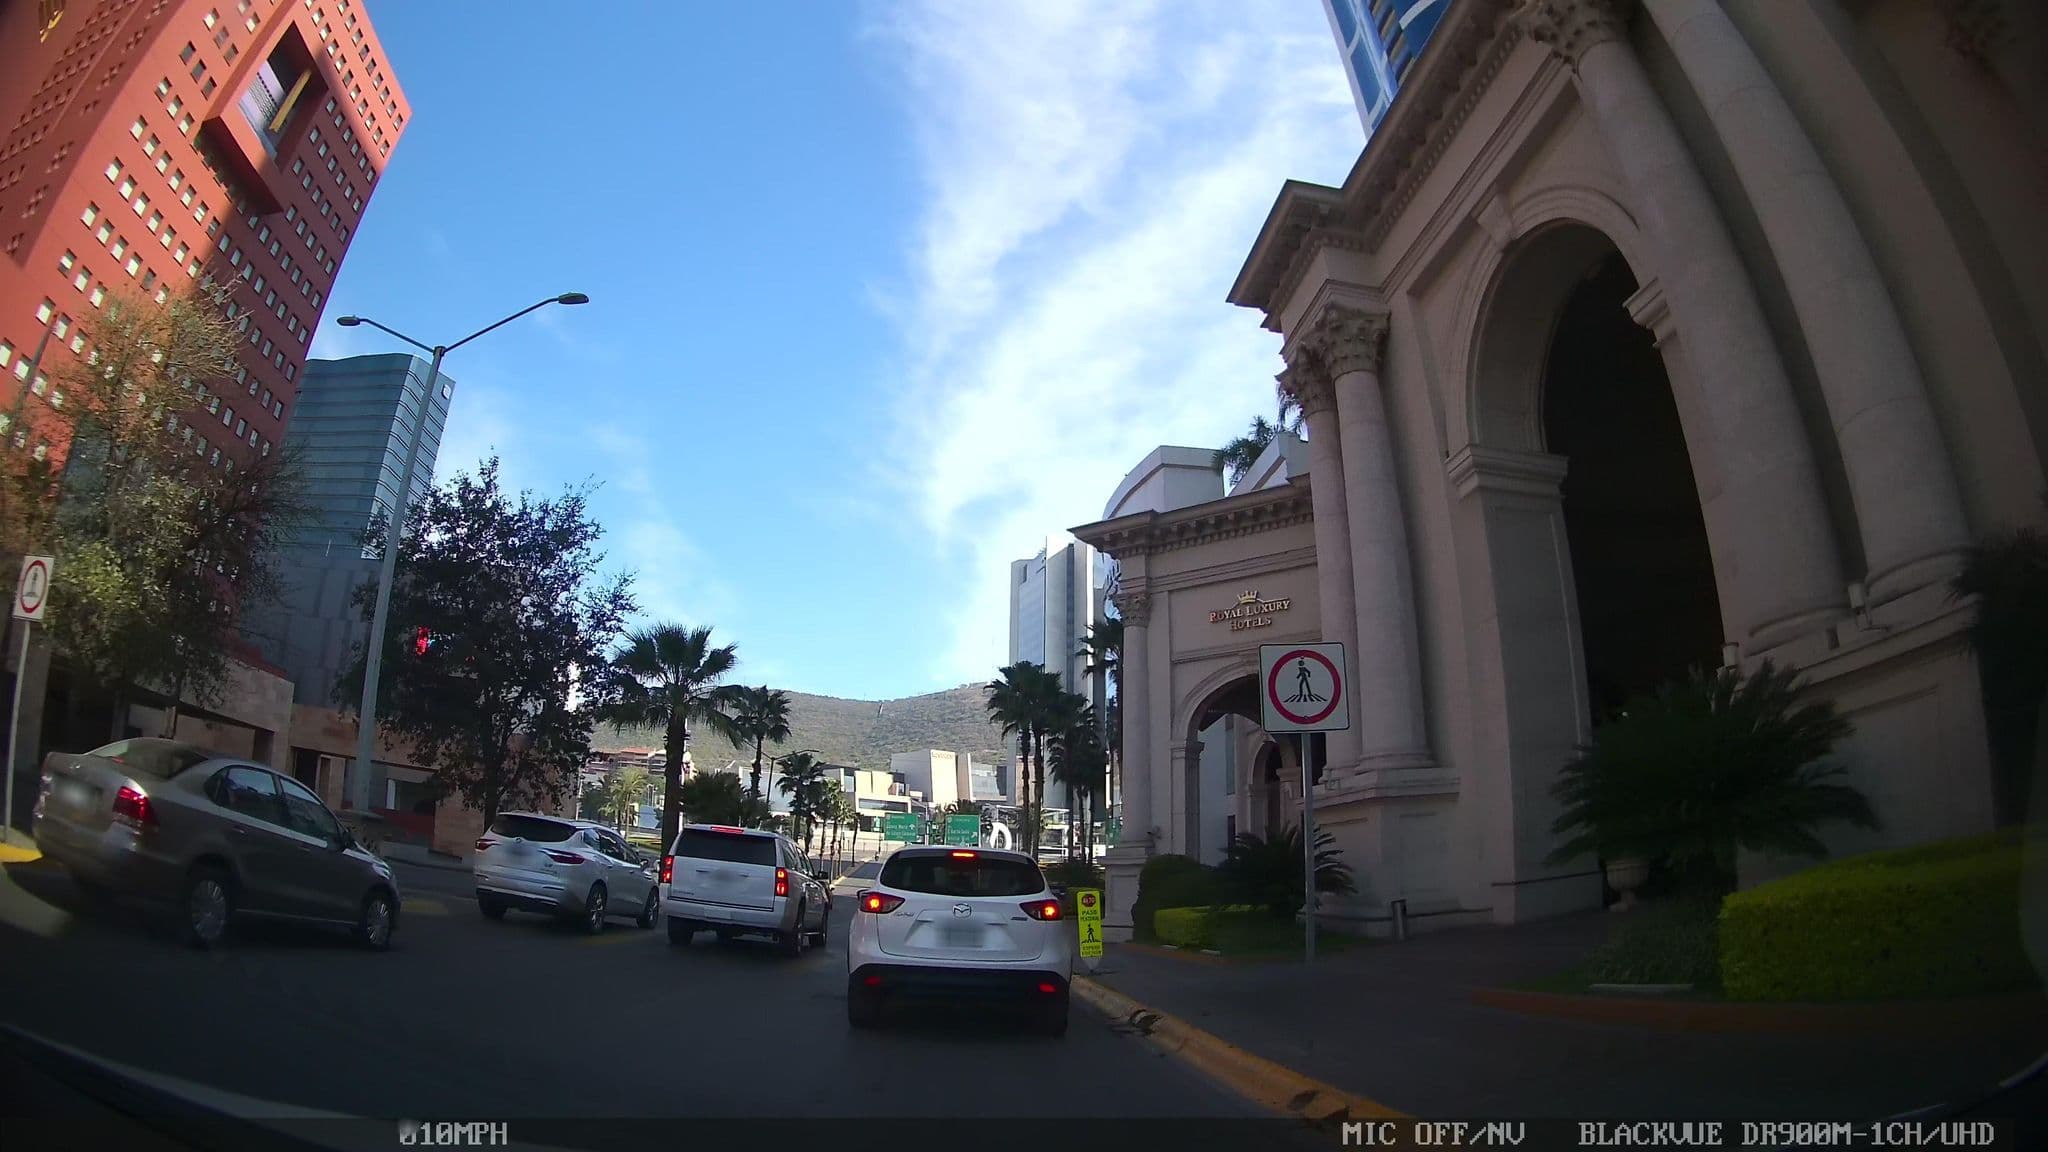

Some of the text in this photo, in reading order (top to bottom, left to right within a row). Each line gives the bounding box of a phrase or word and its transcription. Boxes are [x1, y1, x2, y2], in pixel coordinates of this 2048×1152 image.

[1209, 600, 1290, 622] ROYAL LUXURY
[1230, 617, 1272, 630] HOTELS
